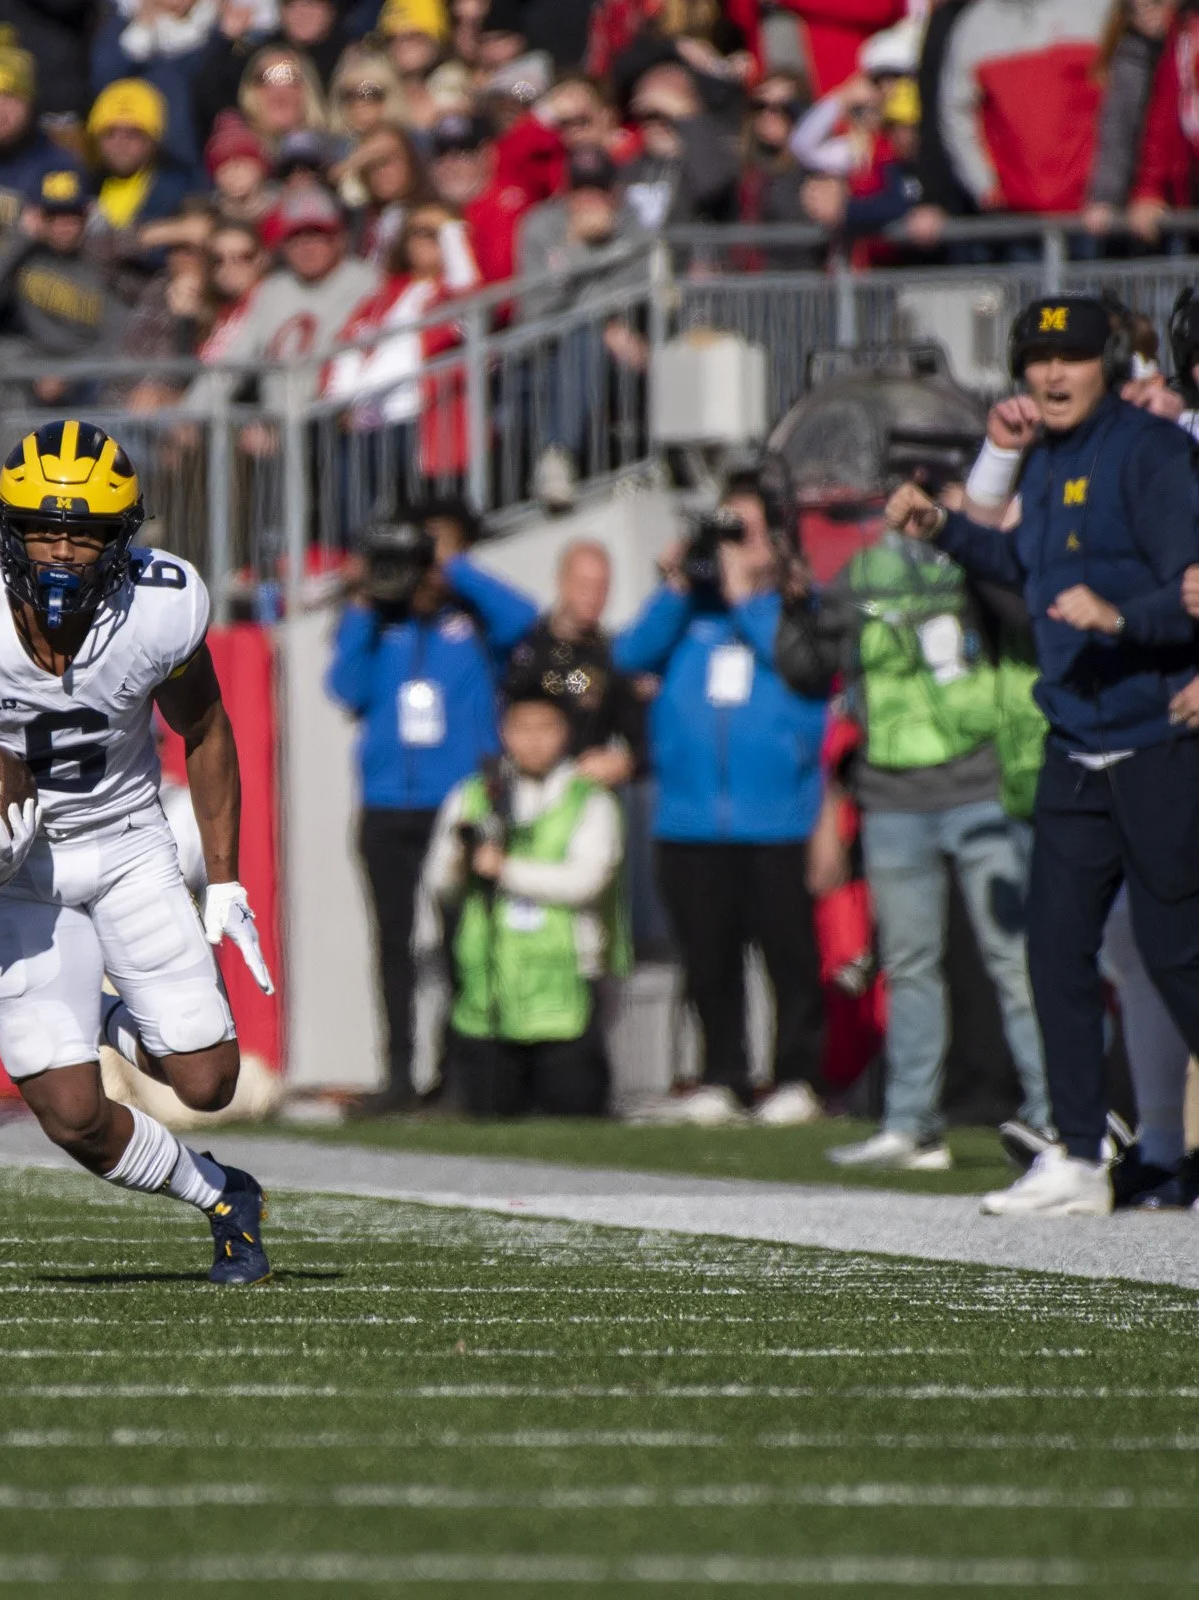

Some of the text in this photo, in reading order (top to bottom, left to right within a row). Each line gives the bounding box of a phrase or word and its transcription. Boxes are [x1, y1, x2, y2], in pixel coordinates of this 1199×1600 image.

[1038, 307, 1069, 331] M
[56, 496, 73, 510] M
[1063, 477, 1089, 506] M
[128, 559, 187, 590] 6
[24, 707, 109, 793] 6
